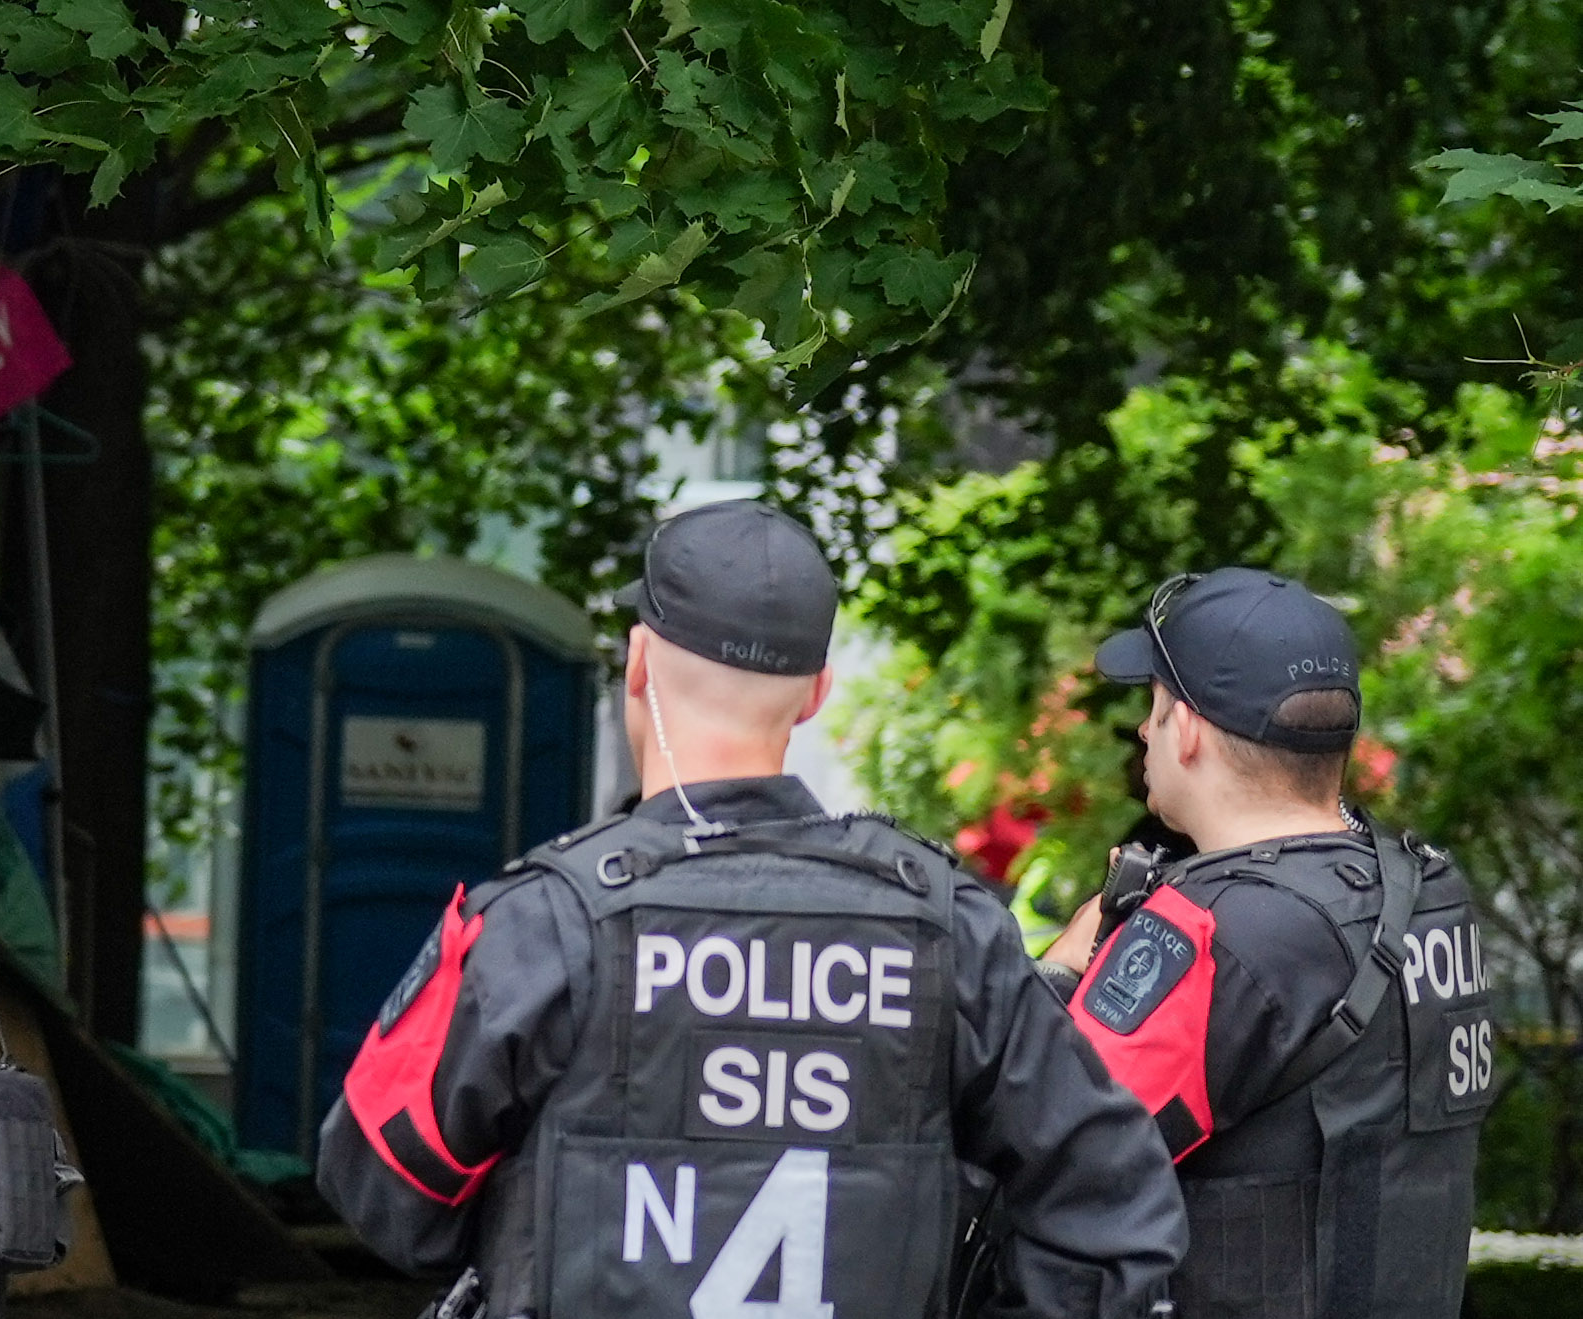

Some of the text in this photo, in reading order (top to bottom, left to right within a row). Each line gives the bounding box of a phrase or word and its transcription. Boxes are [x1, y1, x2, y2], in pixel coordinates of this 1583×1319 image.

[1288, 656, 1351, 681] POLICE
[1132, 914, 1189, 961] POLICE
[1403, 922, 1492, 1005] POLIC
[634, 933, 914, 1029] POLICE
[699, 1046, 852, 1131] SIS
[1448, 1019, 1492, 1096] SIS
